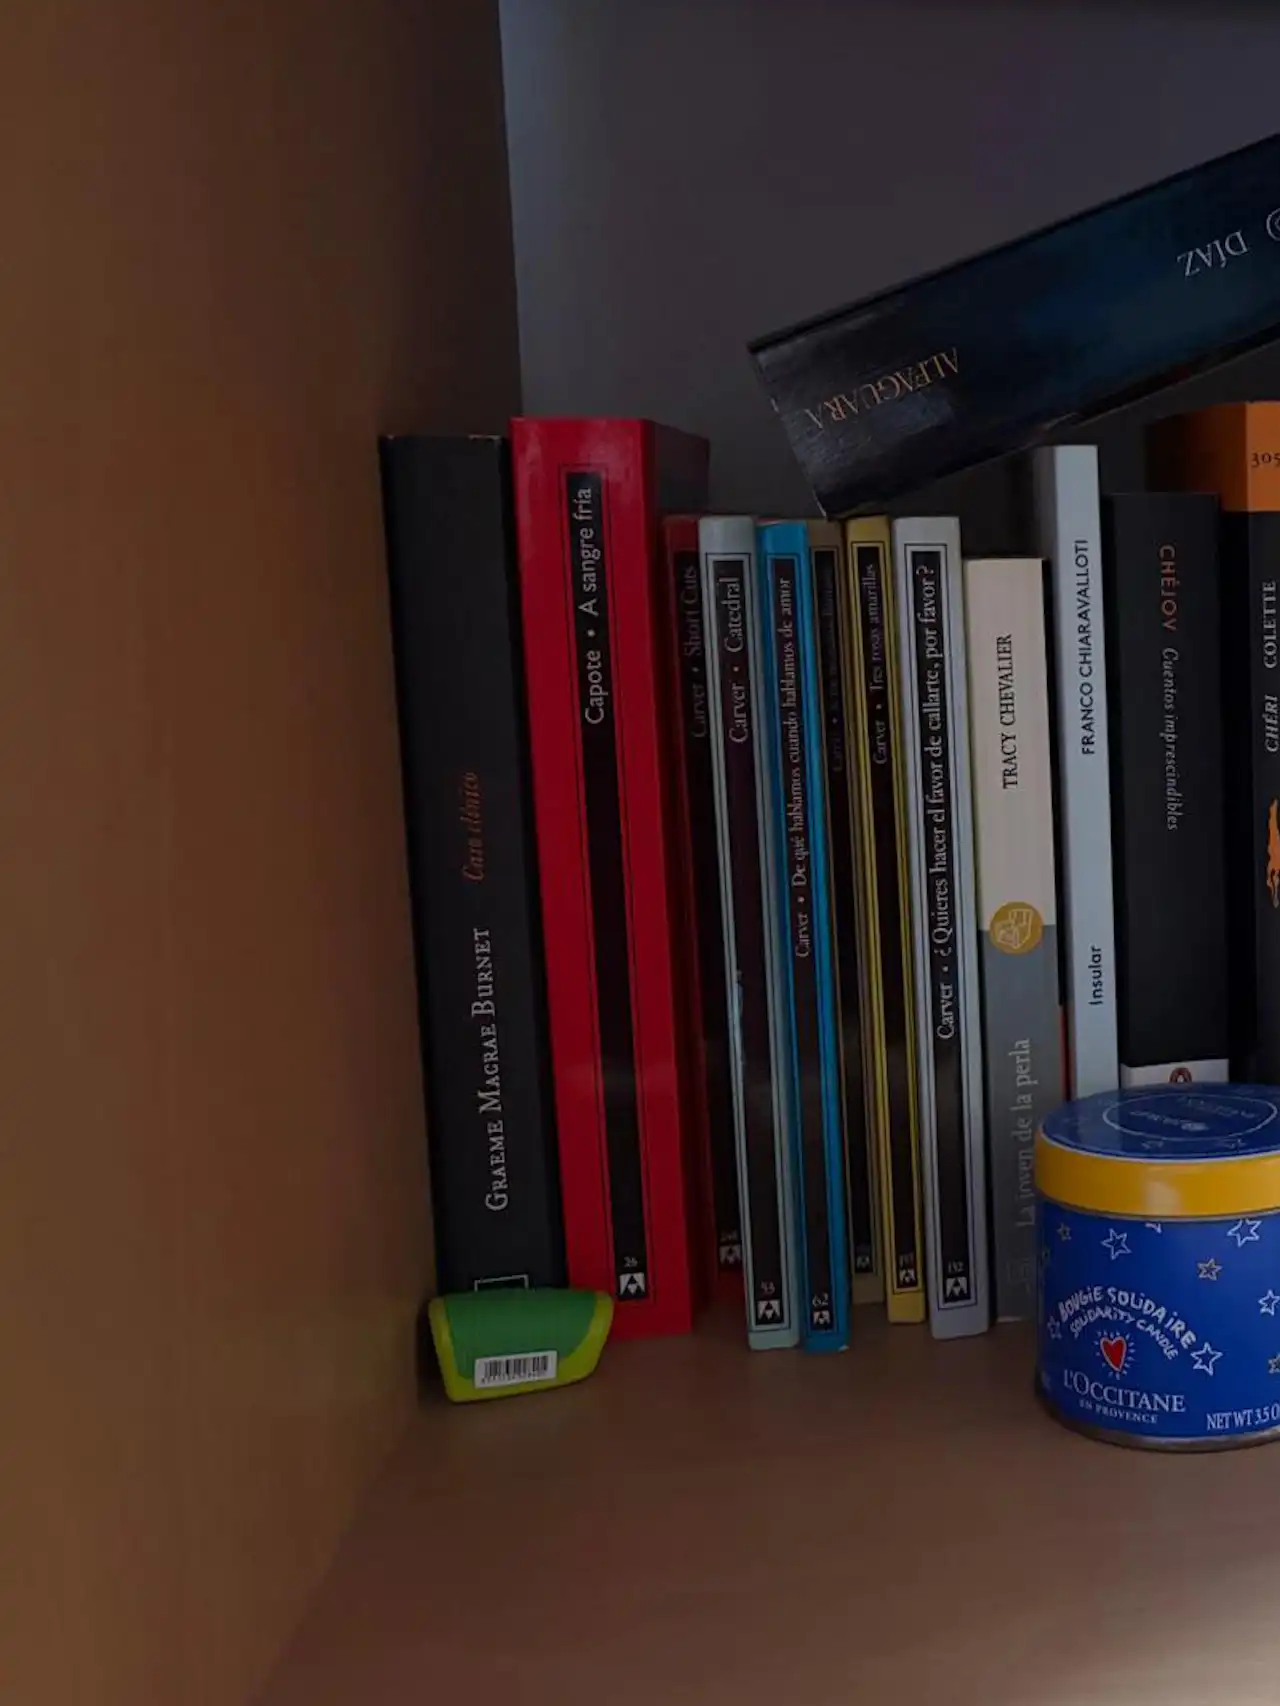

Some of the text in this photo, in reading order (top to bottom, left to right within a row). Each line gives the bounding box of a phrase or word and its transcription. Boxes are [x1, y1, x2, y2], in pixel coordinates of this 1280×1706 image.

[1176, 229, 1250, 277] DÍAZ
[803, 347, 960, 430] ALFAGUARA
[573, 487, 609, 725] Capote A sangre fría
[680, 563, 709, 739] Carver Short Cuts
[717, 576, 749, 744] Carver Catedral
[861, 563, 888, 765] Carver Tres rosas amarillas
[922, 629, 942, 660] por
[1075, 539, 1095, 755] FRANCO CHIARAVALLOTI
[1262, 579, 1279, 753] CHÉRI COLETTE
[921, 662, 944, 734] callarte,
[996, 634, 1018, 789] TRACY CHEVALIER
[1159, 543, 1183, 832] CHÉJOV Cuentos imprescindibles
[777, 577, 811, 958] Carver De qué hablamos cuando hablamos de amor
[923, 735, 944, 756] de
[925, 760, 946, 801] favor
[926, 801, 946, 821] el
[928, 822, 949, 872] hacer
[470, 926, 497, 1017] BURNET
[1088, 945, 1103, 1006] Insular
[936, 980, 955, 1041] Carver
[1008, 1037, 1039, 1086] perla
[1010, 1089, 1033, 1112] la
[1011, 1113, 1033, 1142] de
[484, 1118, 509, 1212] GRAEME
[1015, 1204, 1036, 1228] La
[1136, 1319, 1179, 1360] CANDLE
[1094, 1402, 1159, 1425] PROVENCE
[1206, 1411, 1232, 1432] NET
[1231, 1408, 1255, 1429] WT
